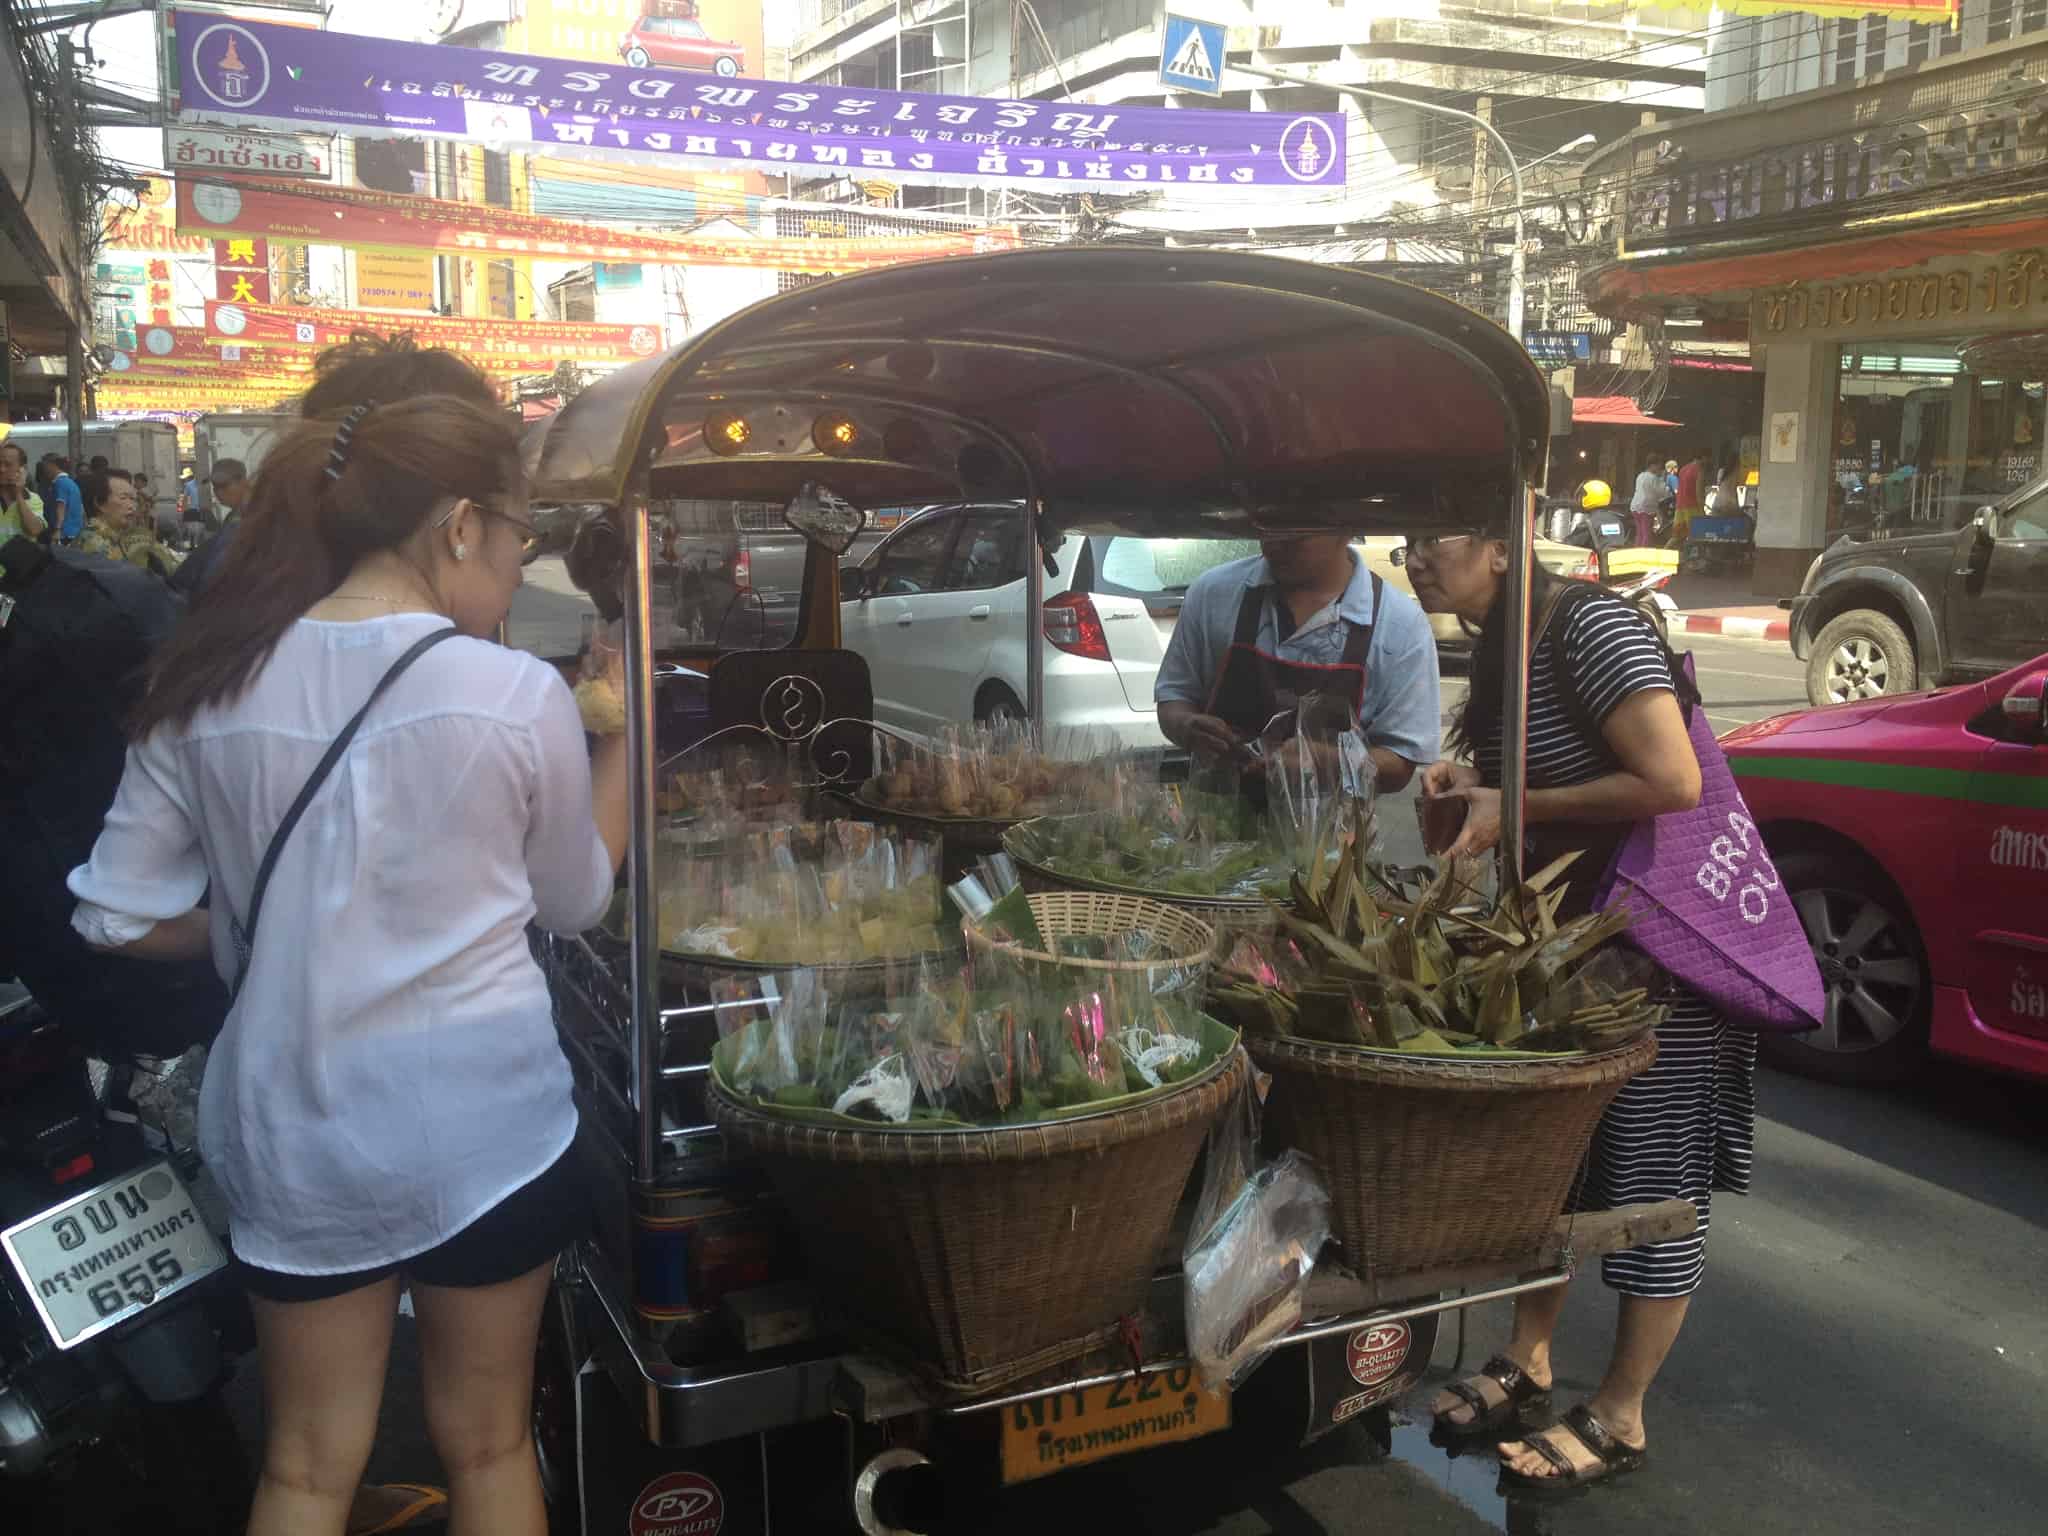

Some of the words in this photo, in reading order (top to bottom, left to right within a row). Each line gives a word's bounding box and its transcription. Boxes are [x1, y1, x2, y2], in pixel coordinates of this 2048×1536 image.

[482, 61, 1120, 138] ทรงพระเจริญ
[551, 115, 933, 170] ห้างขายทอง
[52, 1185, 149, 1251] อบน
[40, 1208, 195, 1298] กรุงเทพมหานคร
[87, 1249, 183, 1317] 655
[655, 1496, 699, 1518] PY
